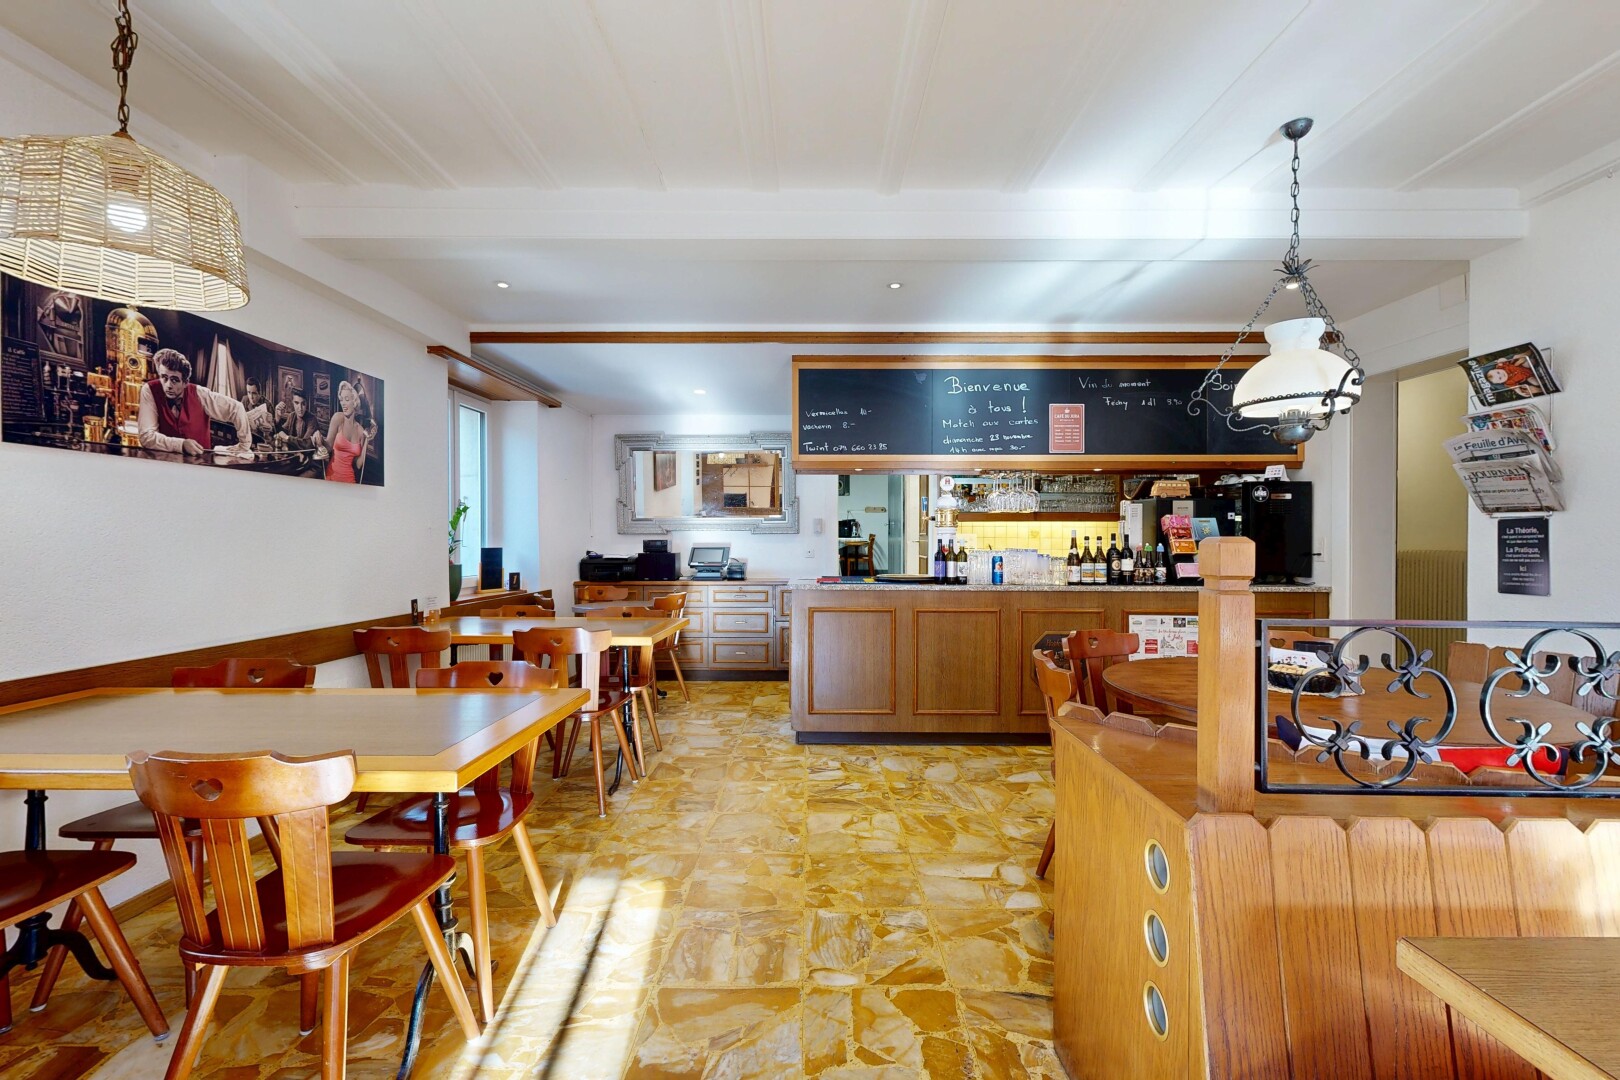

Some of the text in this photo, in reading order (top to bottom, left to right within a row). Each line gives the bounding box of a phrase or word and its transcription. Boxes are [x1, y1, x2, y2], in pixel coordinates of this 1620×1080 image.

[944, 376, 1030, 394] Bienvenue
[1078, 376, 1151, 389] Vin du moment
[1467, 360, 1496, 403] magazine
[968, 396, 1027, 414] à tous !
[942, 419, 975, 428] Match
[1008, 416, 1039, 426] cartes
[942, 435, 983, 444] dimanche
[1464, 438, 1497, 450] Feuille
[803, 442, 829, 452] Twint
[1470, 468, 1520, 483] JOURNAL
[1513, 546, 1540, 554] Pratique,
